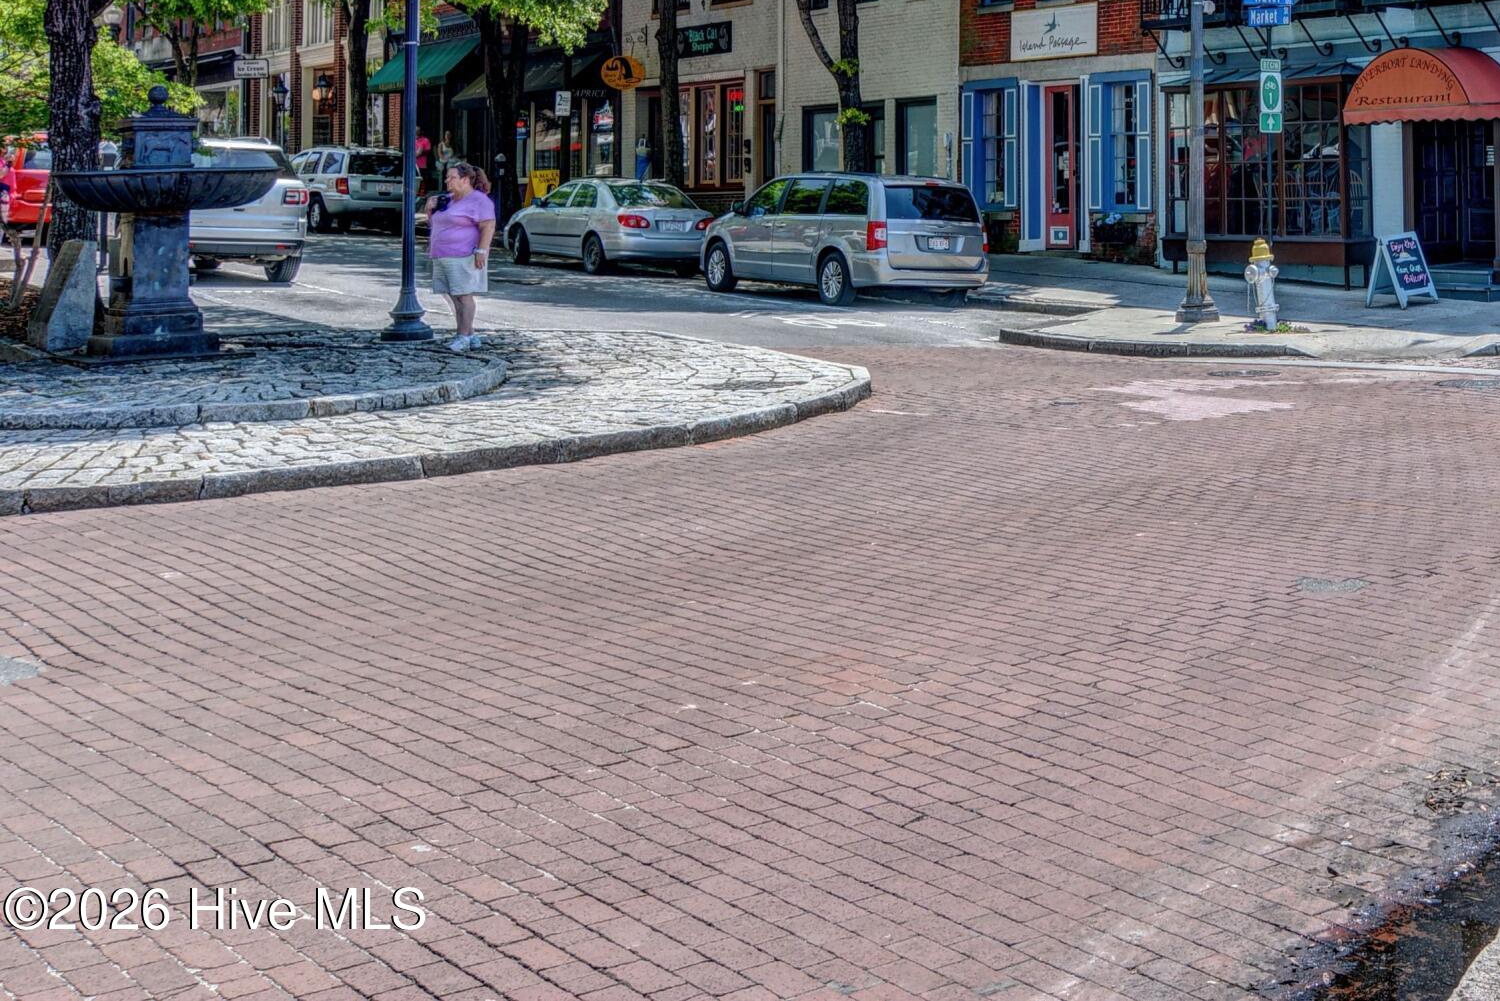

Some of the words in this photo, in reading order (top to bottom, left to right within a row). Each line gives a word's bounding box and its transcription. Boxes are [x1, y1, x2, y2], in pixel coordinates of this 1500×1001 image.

[1250, 9, 1277, 25] Market
[689, 30, 704, 42] Black
[706, 27, 717, 39] Cat
[691, 42, 713, 53] Shoppe
[1019, 36, 1046, 53] Island
[1048, 35, 1087, 51] Passage
[1263, 61, 1279, 70] BEGIN
[1354, 56, 1407, 93] RIVERBOAT
[1410, 57, 1456, 91] LANDING
[572, 89, 607, 97] APRICE
[1268, 92, 1273, 105] 1
[1355, 93, 1451, 105] Restaurant
